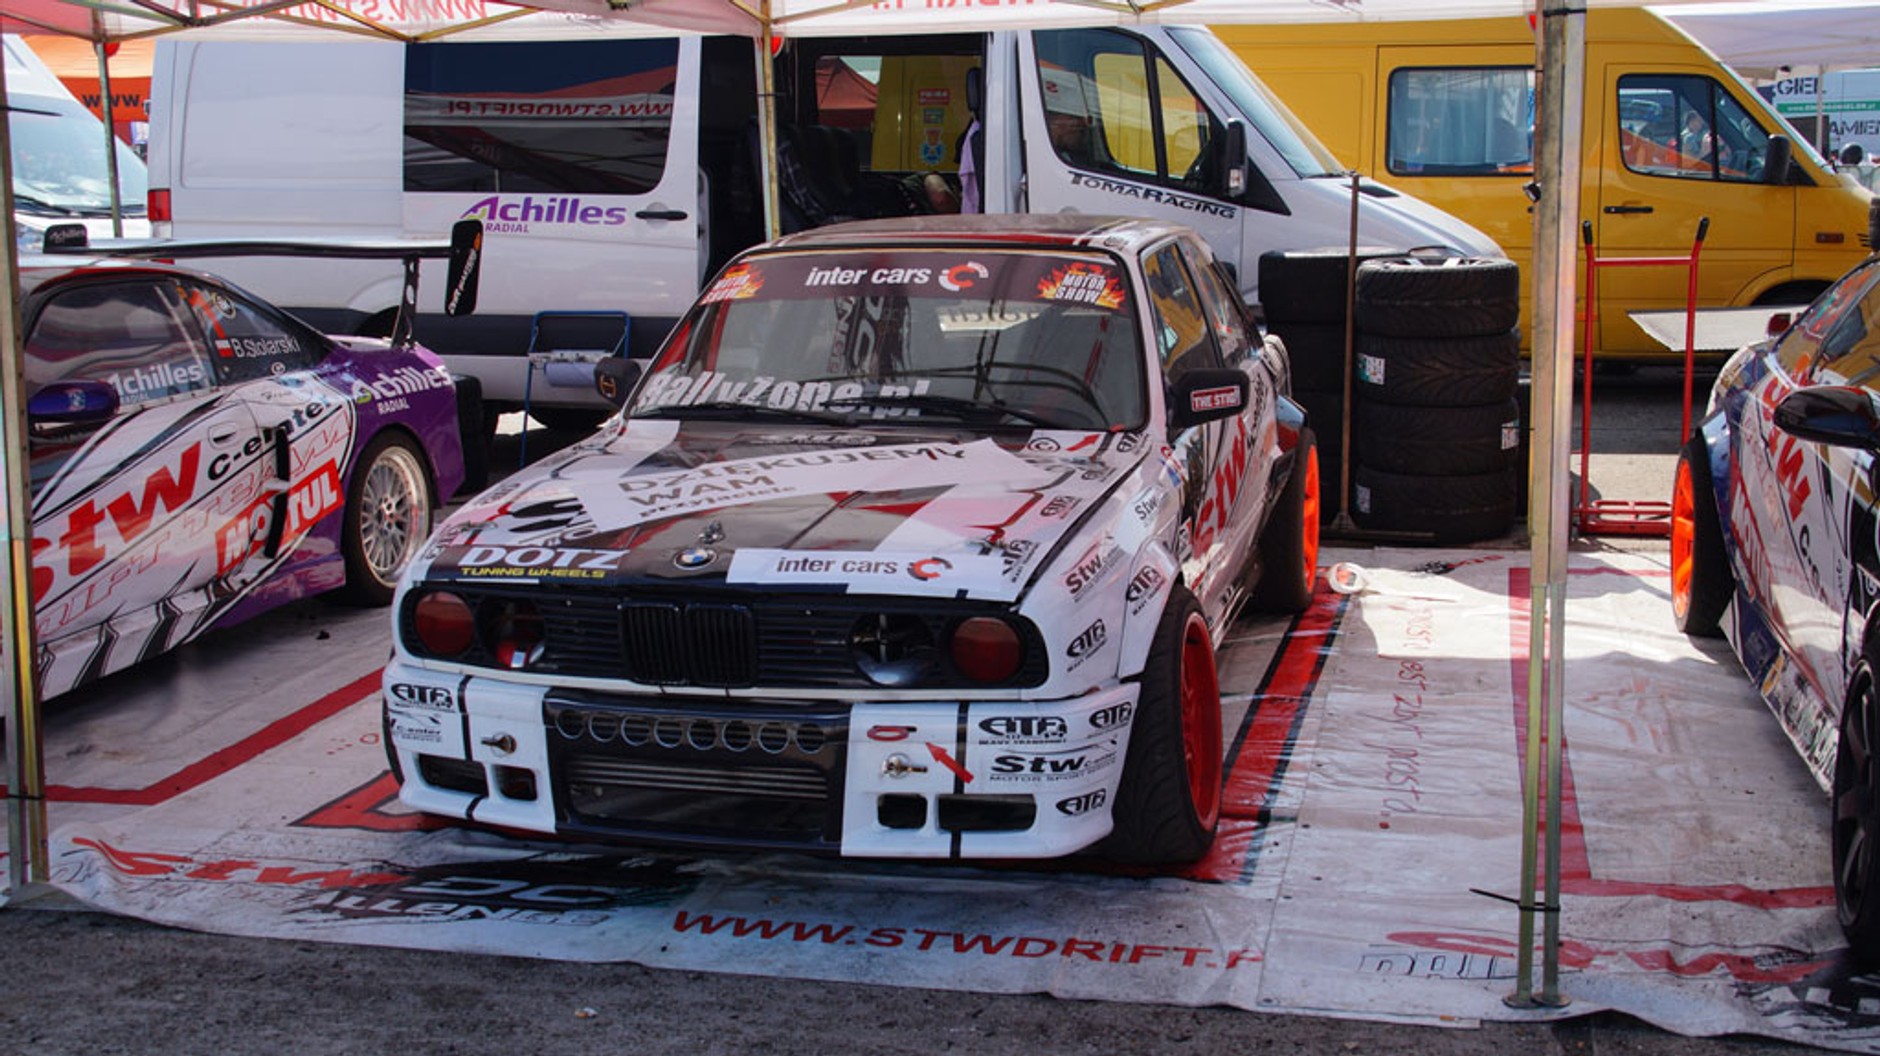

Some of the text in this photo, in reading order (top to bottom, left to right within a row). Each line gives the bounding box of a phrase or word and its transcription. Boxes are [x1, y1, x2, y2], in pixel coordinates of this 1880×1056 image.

[460, 196, 627, 226] Achilles
[485, 223, 531, 235] RADIAL
[806, 265, 932, 287] inter cars
[1062, 272, 1107, 290] MOTOR
[1055, 285, 1101, 303] SHOW
[352, 366, 453, 403] Achilles
[628, 475, 776, 506] WAM
[222, 471, 339, 569] MOTUL
[457, 546, 631, 570] DOTZ
[776, 556, 899, 575] inter cars
[461, 566, 607, 579] TUNING WHEELS
[1066, 555, 1103, 595] Stw
[991, 755, 1087, 774] Stw
